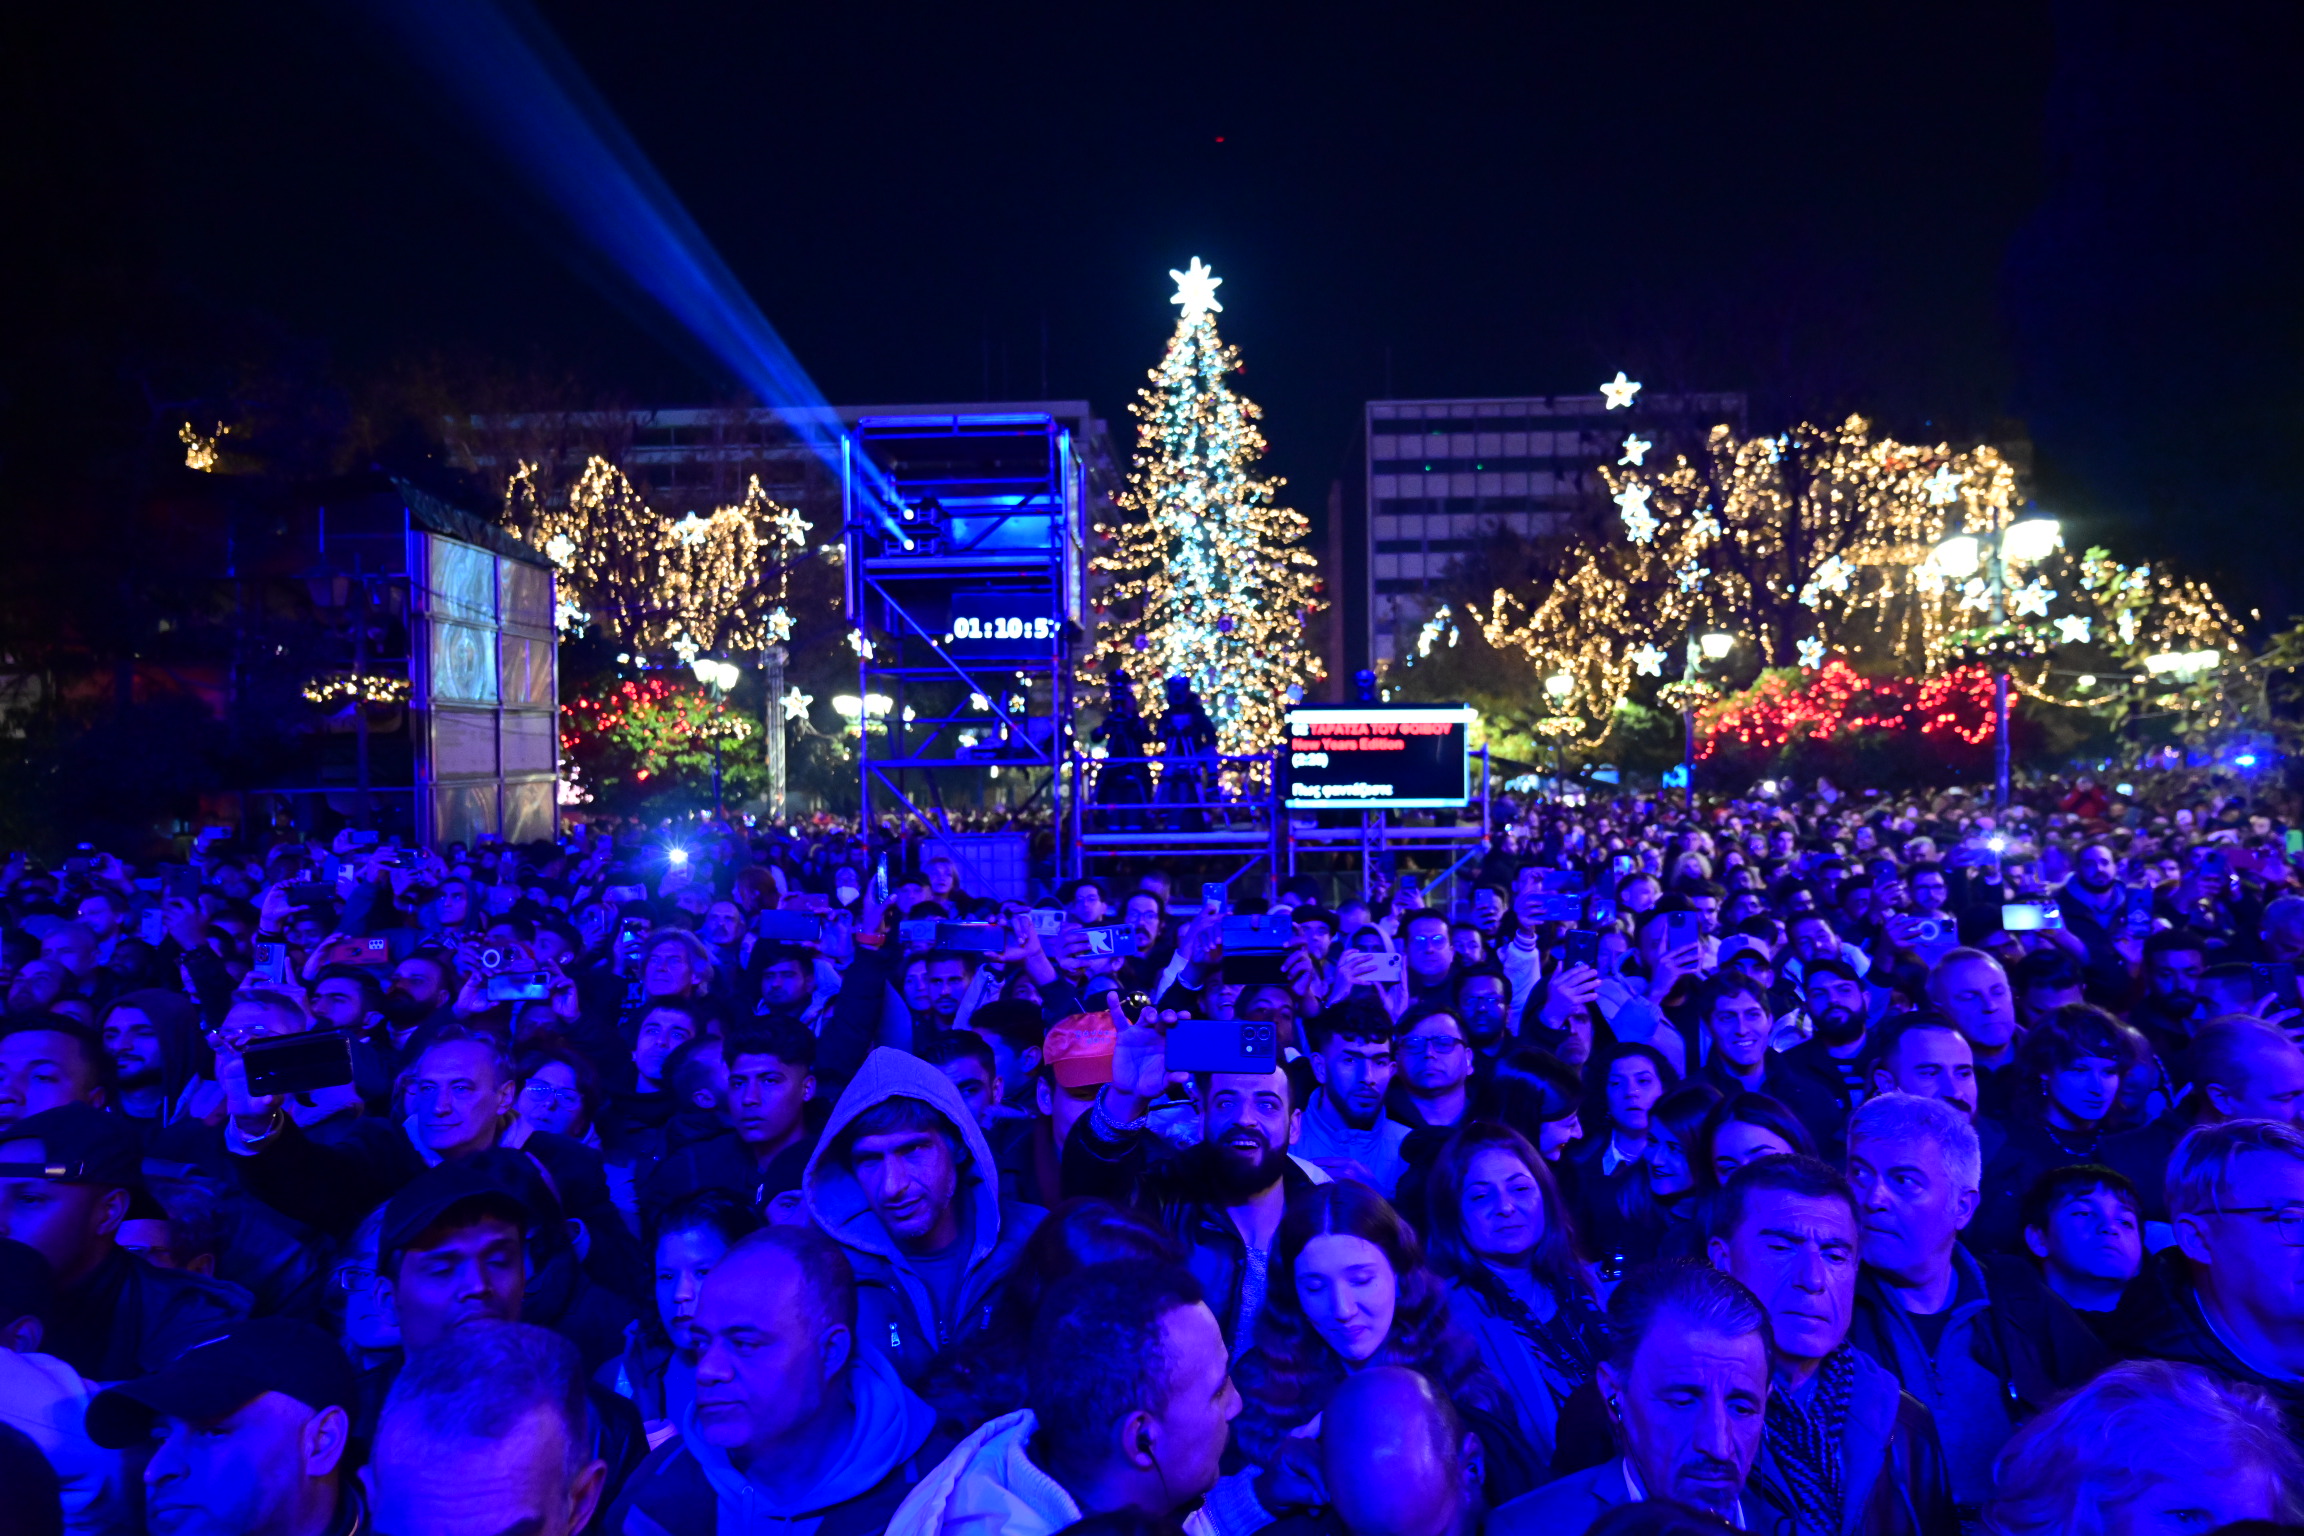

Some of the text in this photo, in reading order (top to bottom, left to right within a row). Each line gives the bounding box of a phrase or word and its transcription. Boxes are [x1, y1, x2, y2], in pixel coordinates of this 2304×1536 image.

[1291, 737, 1405, 751] New Years Edition
